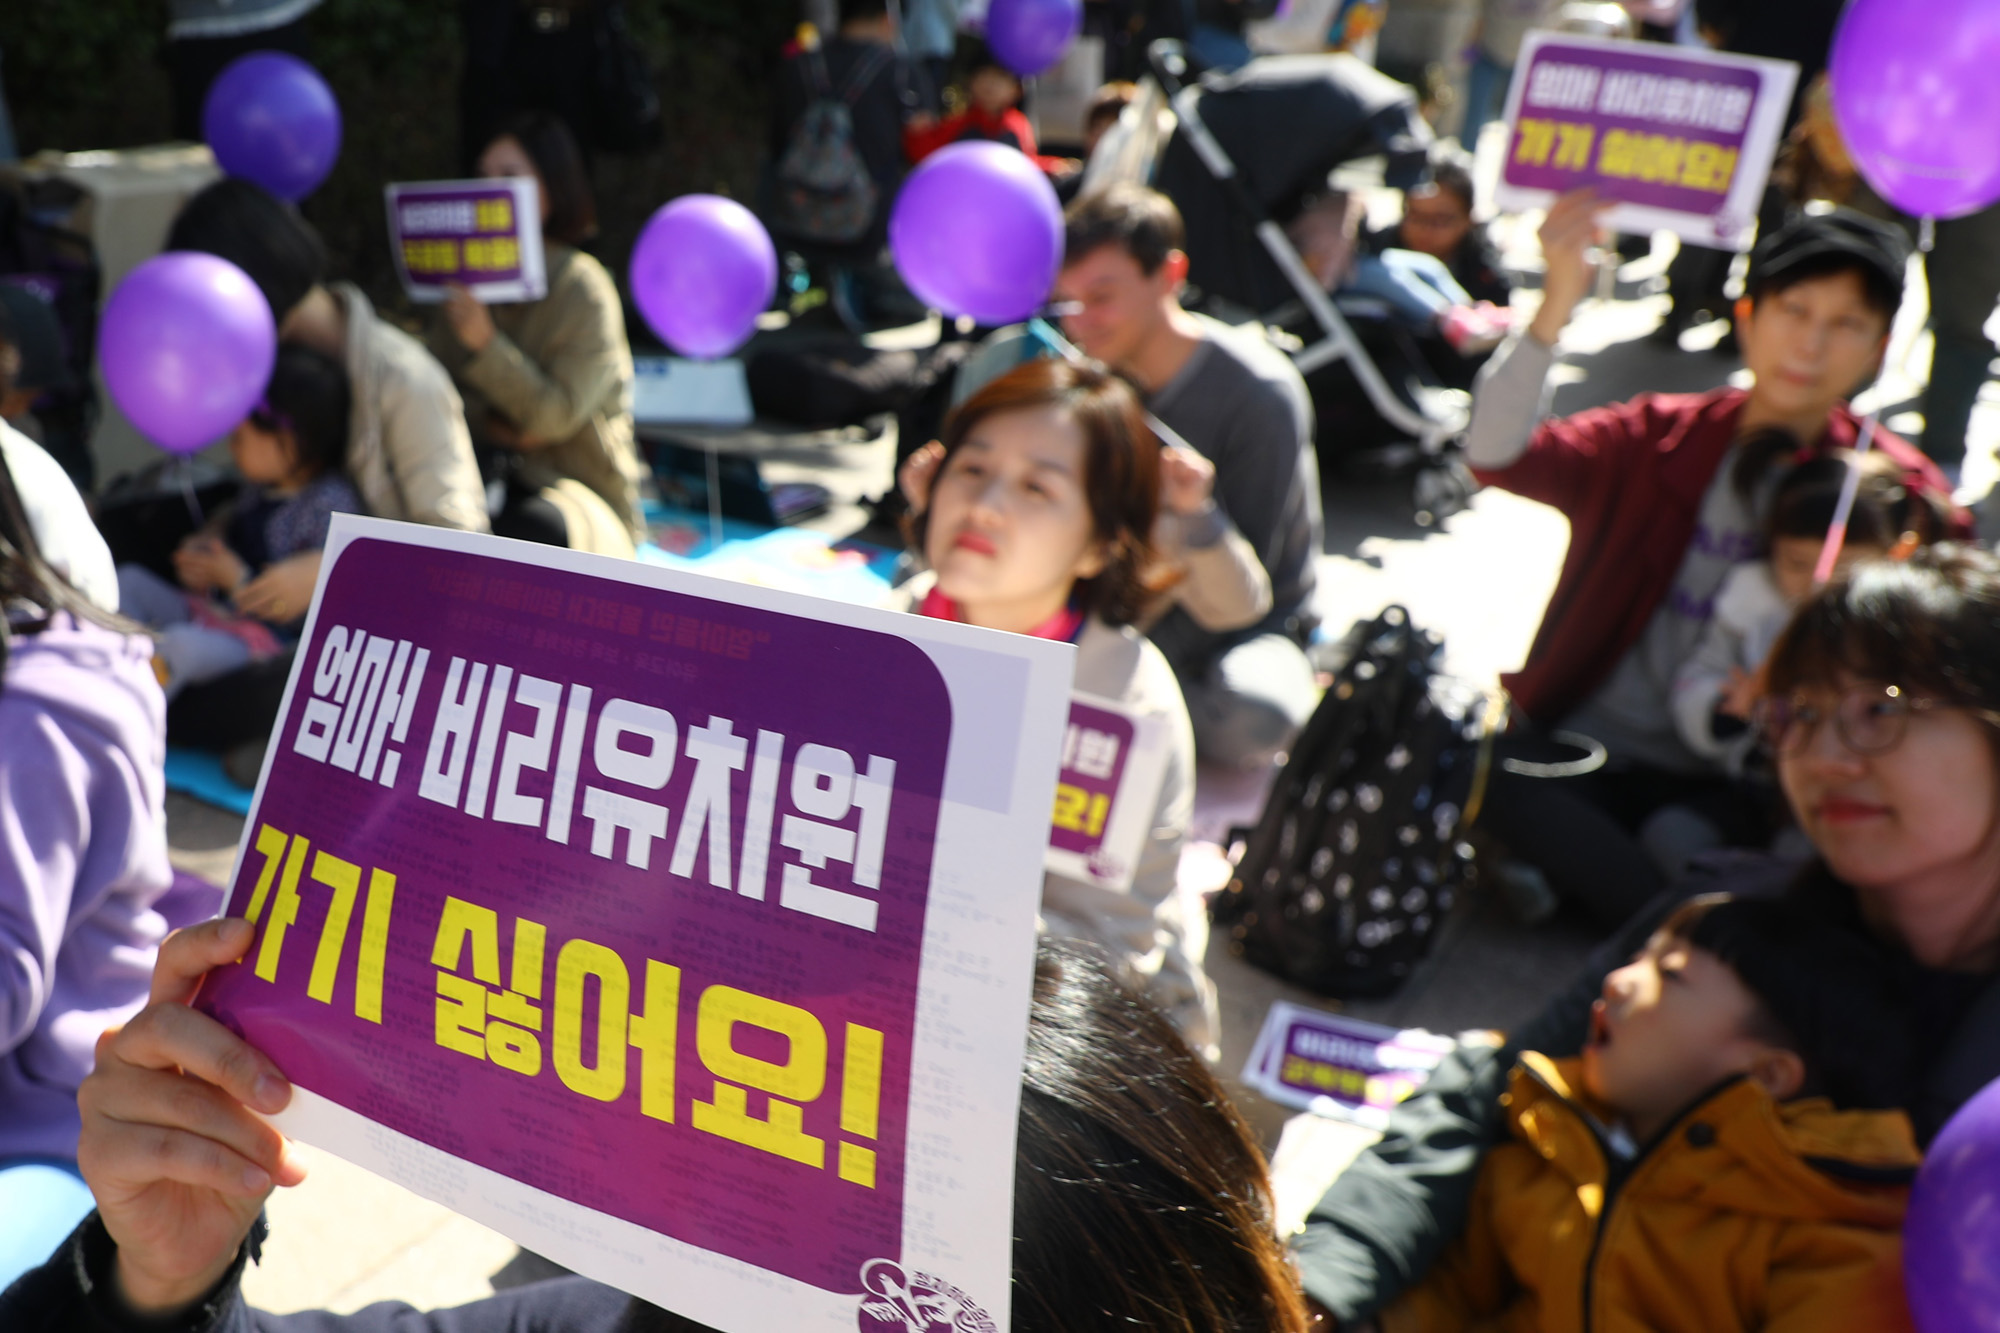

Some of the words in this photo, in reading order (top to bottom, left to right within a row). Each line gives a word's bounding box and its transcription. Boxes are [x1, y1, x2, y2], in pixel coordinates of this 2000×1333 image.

[293, 624, 431, 789] 엄마!
[418, 656, 896, 933] 비리유치원
[235, 823, 397, 1025] 가기
[430, 895, 884, 1189] 싫어요!
